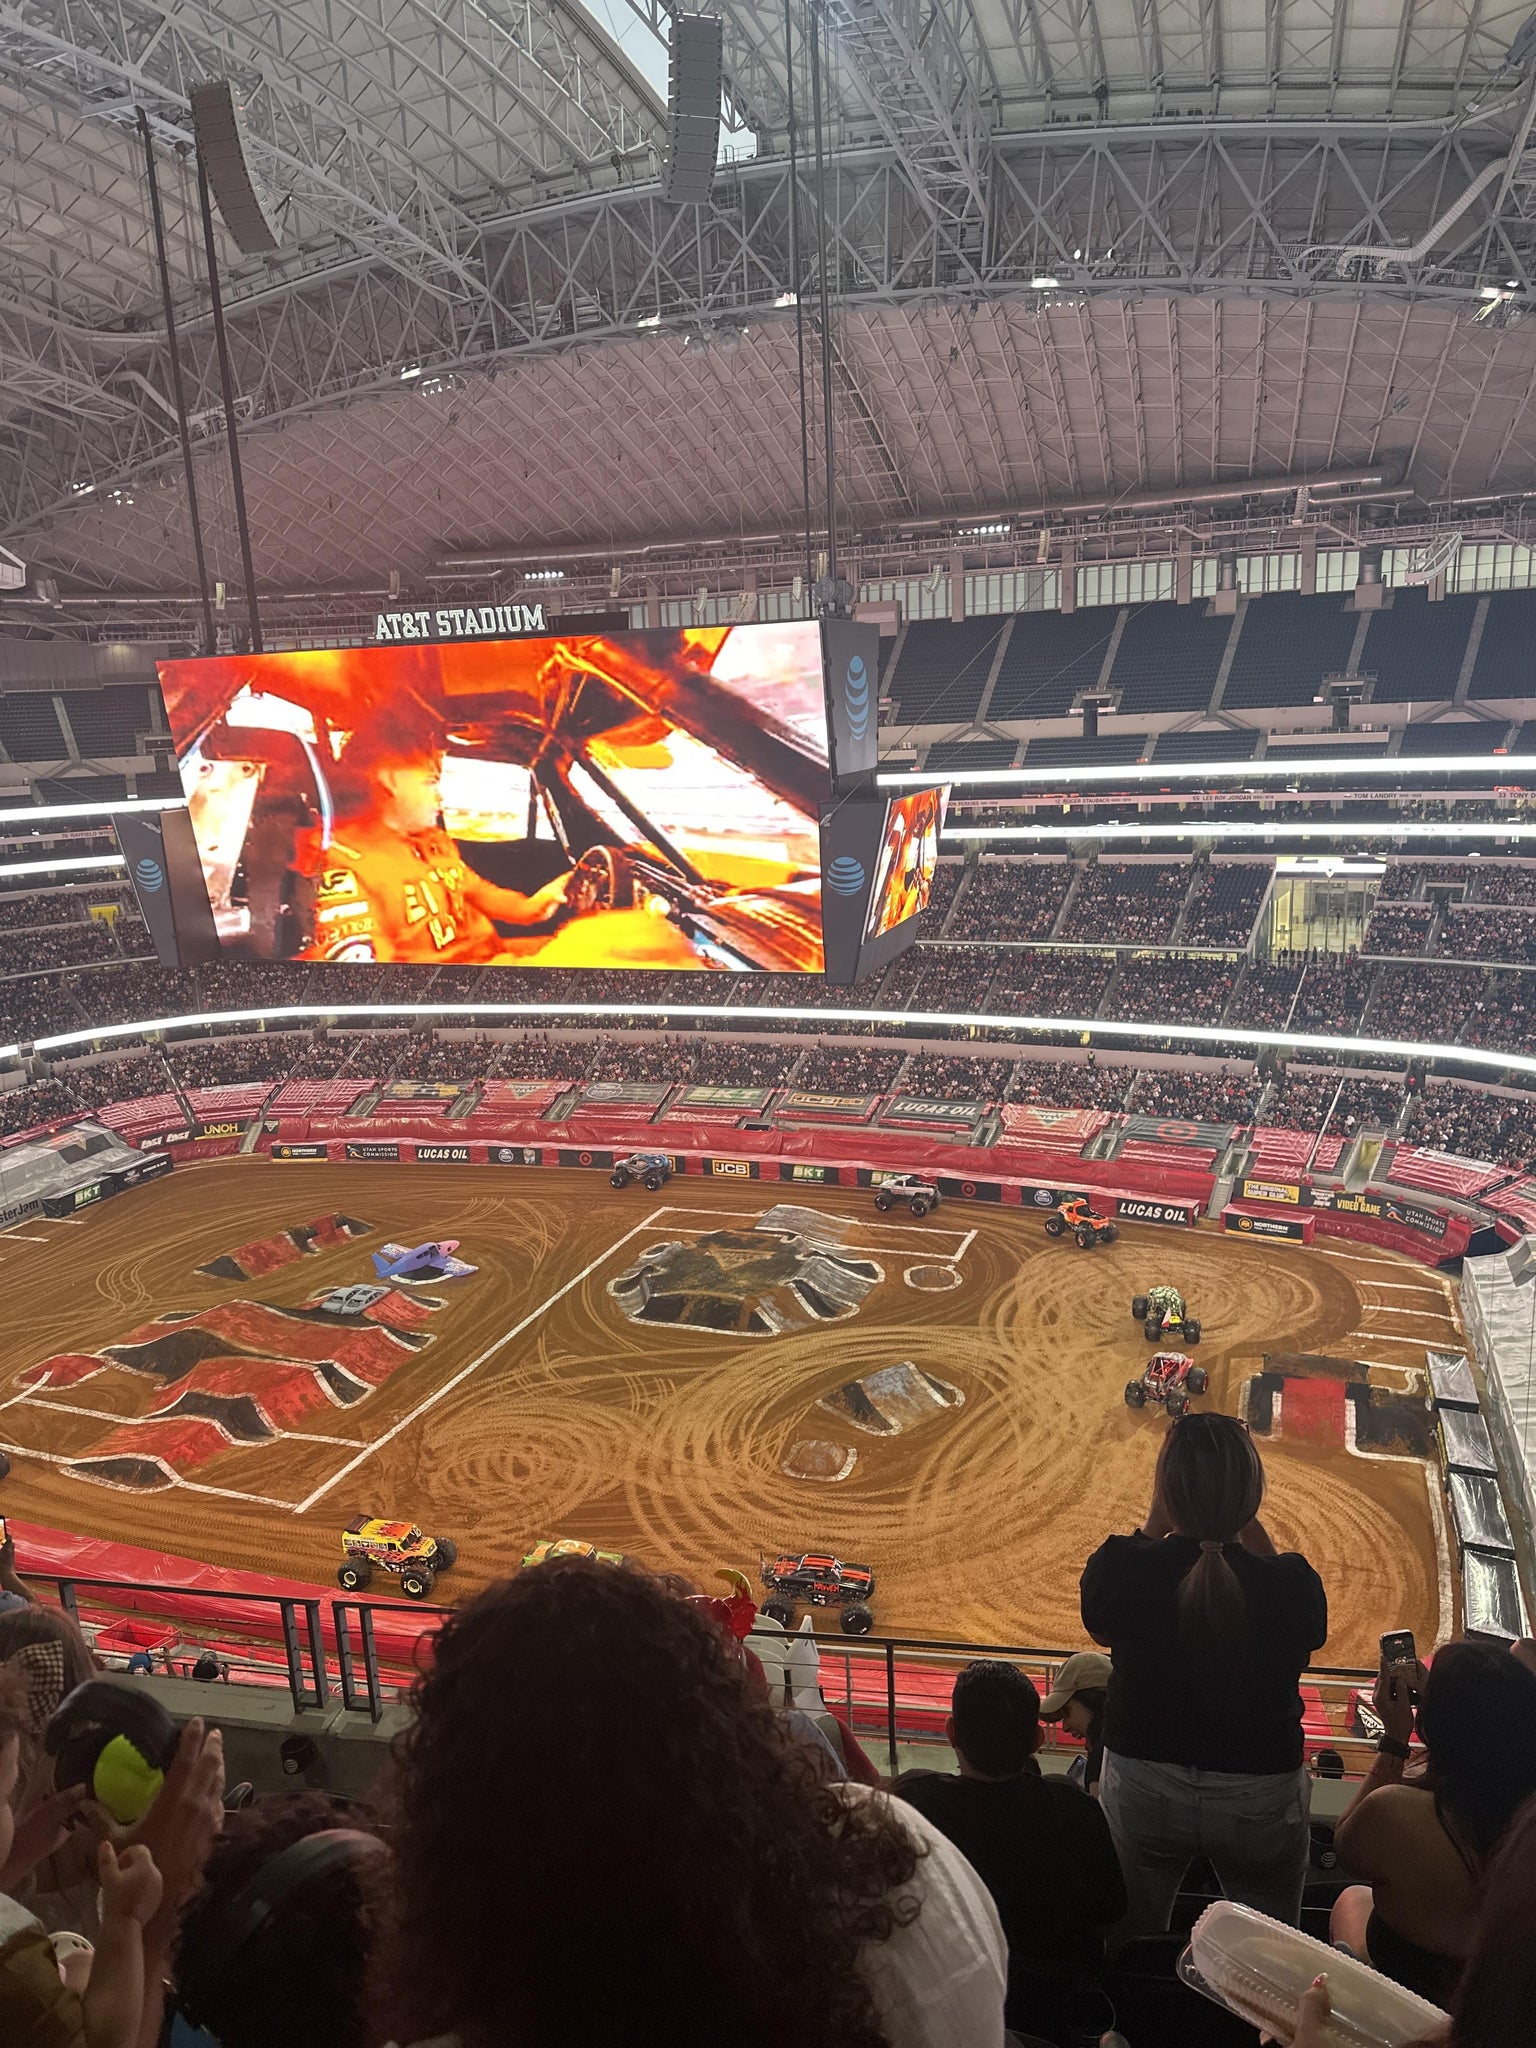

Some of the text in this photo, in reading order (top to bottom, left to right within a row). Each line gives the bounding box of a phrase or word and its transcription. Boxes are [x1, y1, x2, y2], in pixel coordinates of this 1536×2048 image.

[376, 604, 546, 640] AT&T STADIUM
[893, 1101, 978, 1116] LUCAS OIL
[203, 1123, 239, 1134] UNOH
[418, 1148, 468, 1159] LUCAS OIL
[716, 1165, 748, 1174] JCB
[793, 1166, 824, 1178] BKT
[75, 1187, 99, 1204] BKT
[1120, 1203, 1187, 1222] LUCAS OIL
[1337, 1199, 1358, 1211] VIDEO
[1360, 1202, 1381, 1215] GAME
[1254, 1222, 1289, 1231] NORTHERN
[1405, 1216, 1444, 1234] COMMISSION
[1406, 1210, 1446, 1229] UTAH SPORTS
